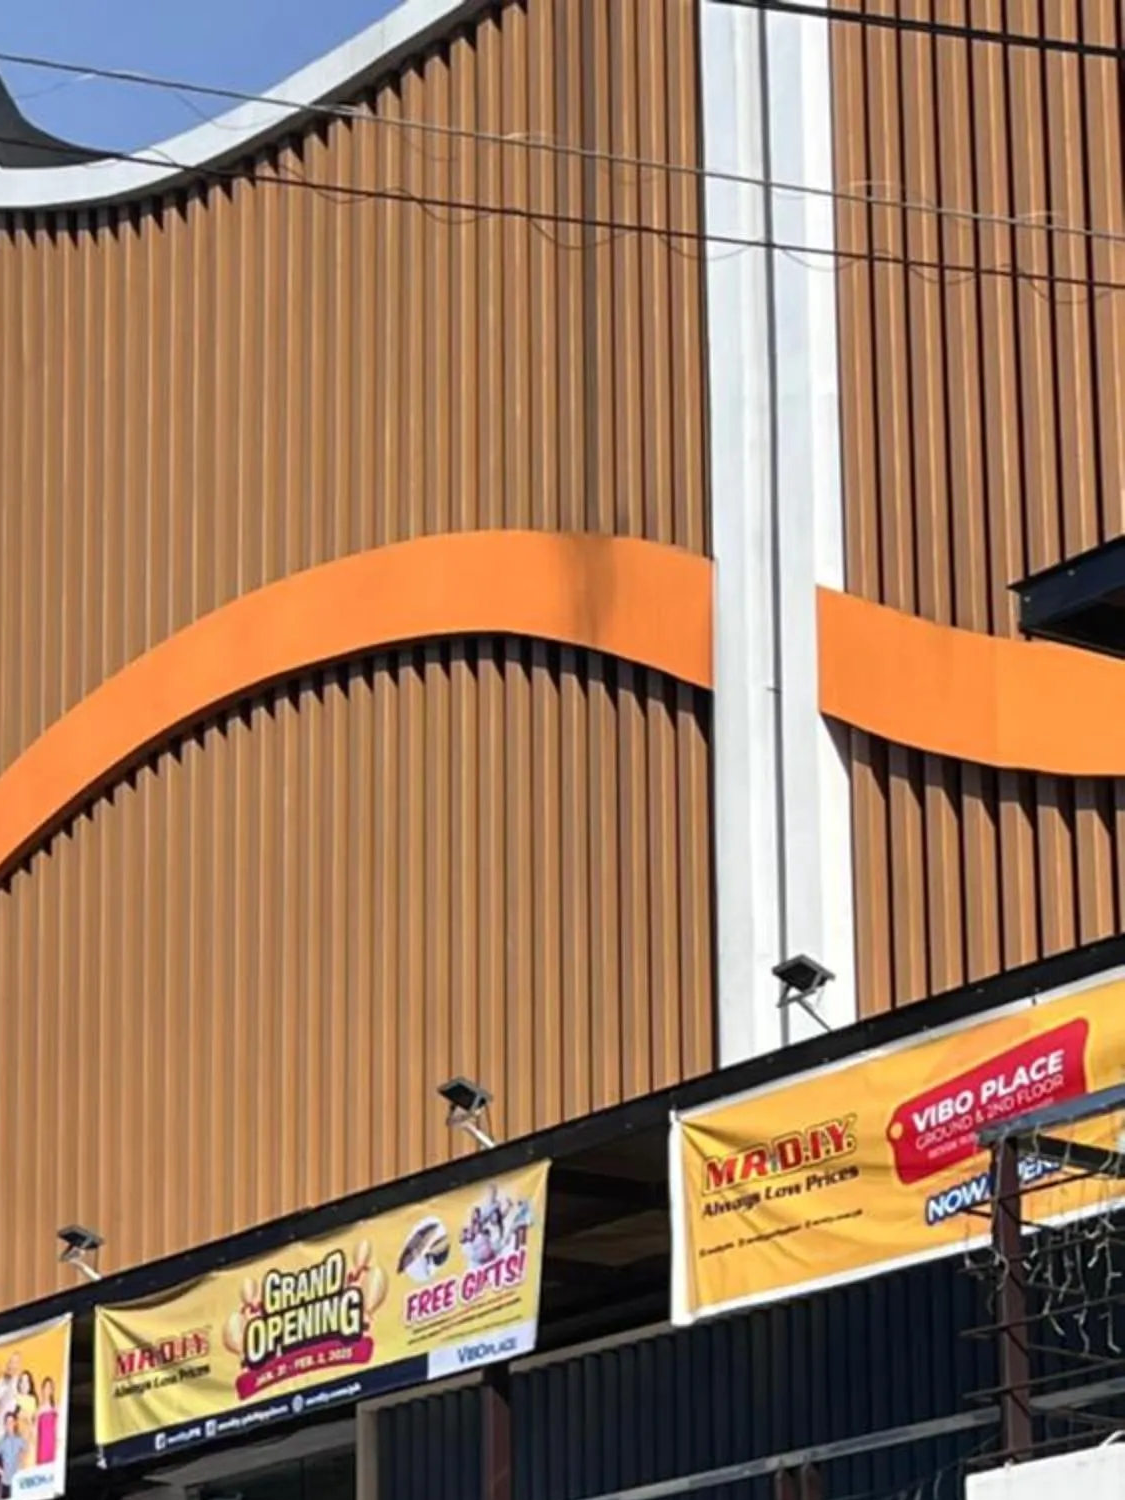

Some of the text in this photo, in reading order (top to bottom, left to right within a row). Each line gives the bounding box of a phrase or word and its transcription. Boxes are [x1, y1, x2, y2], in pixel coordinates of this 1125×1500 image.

[911, 1091, 974, 1133] VIBO
[980, 1048, 1065, 1105] PLACE
[1016, 1074, 1064, 1106] FLOOR
[702, 1165, 860, 1219] Always Low Prices
[928, 1178, 987, 1222] NOW
[264, 1251, 344, 1314] GRAND
[406, 1279, 456, 1321] FREE
[461, 1250, 525, 1301] GIFTS!
[246, 1288, 362, 1362] OPENING
